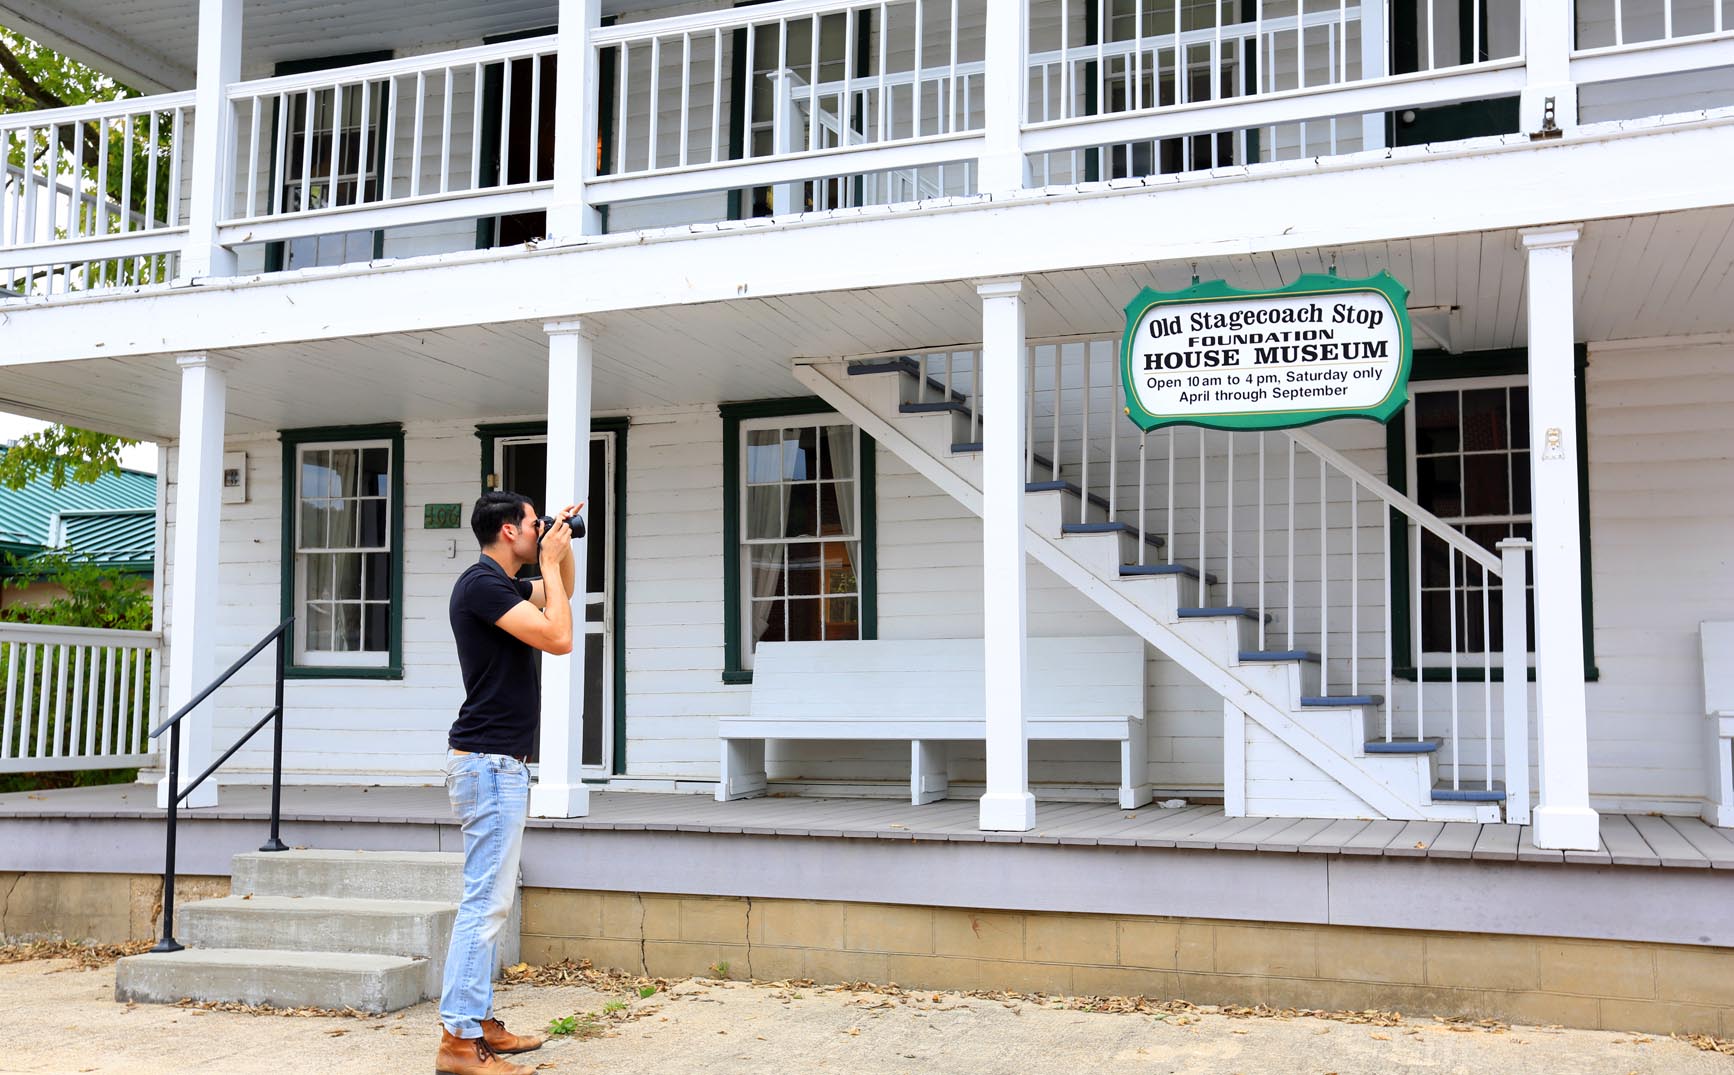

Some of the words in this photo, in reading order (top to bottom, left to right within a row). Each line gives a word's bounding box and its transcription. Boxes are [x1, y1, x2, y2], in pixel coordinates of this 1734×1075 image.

[1149, 319, 1183, 339] Old
[1190, 304, 1323, 332] Stagecoach
[1332, 303, 1384, 329] Stop
[1188, 329, 1334, 347] FOUNDATION
[1144, 349, 1240, 370] HOUSE
[1254, 340, 1388, 365] MUSEUM
[1147, 377, 1182, 390] Open
[1227, 375, 1240, 385] to
[1286, 369, 1348, 383] Saturday
[1353, 367, 1383, 381] only
[1179, 391, 1210, 404] April
[1215, 387, 1267, 402] through
[1272, 385, 1348, 400] September
